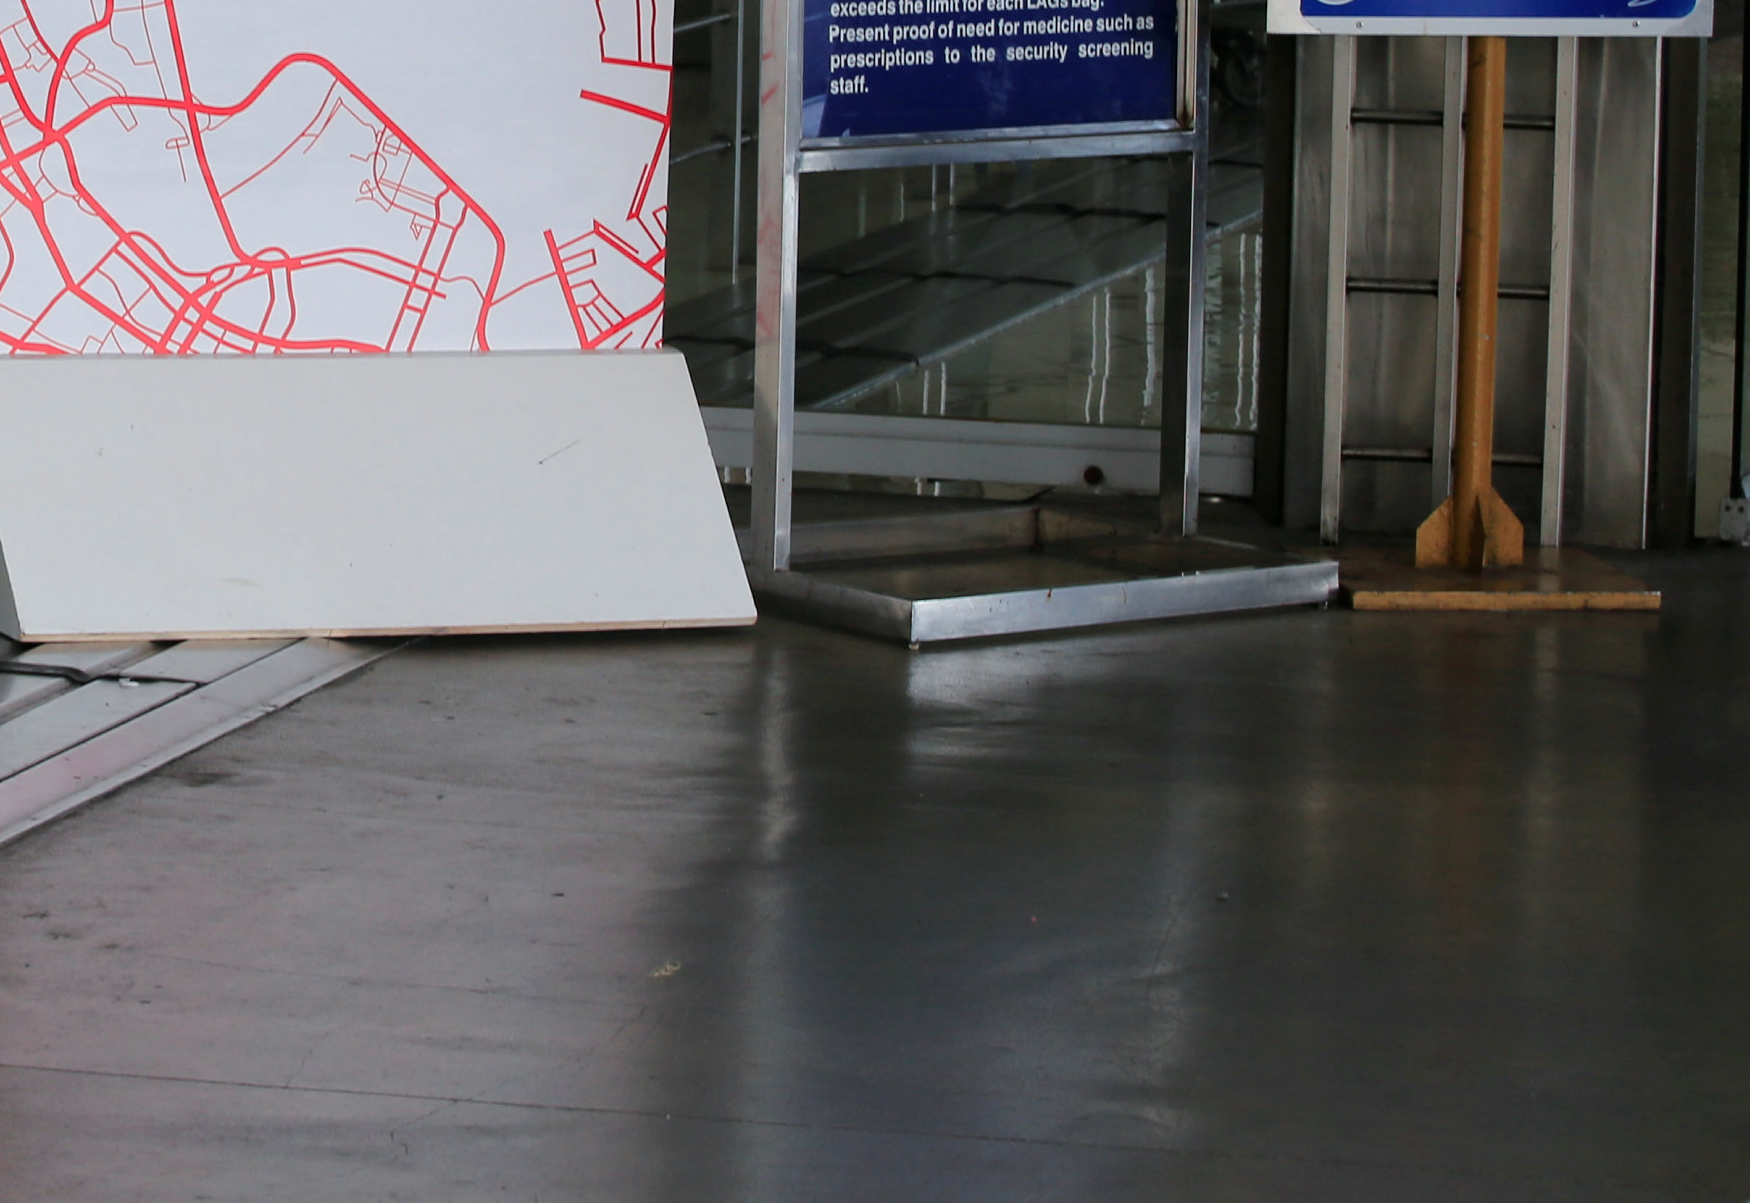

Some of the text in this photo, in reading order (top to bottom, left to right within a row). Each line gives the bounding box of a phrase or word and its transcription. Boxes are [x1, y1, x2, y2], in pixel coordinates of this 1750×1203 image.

[830, 39, 1152, 69] prescriptions to the security screening
[830, 75, 868, 93] staff.
